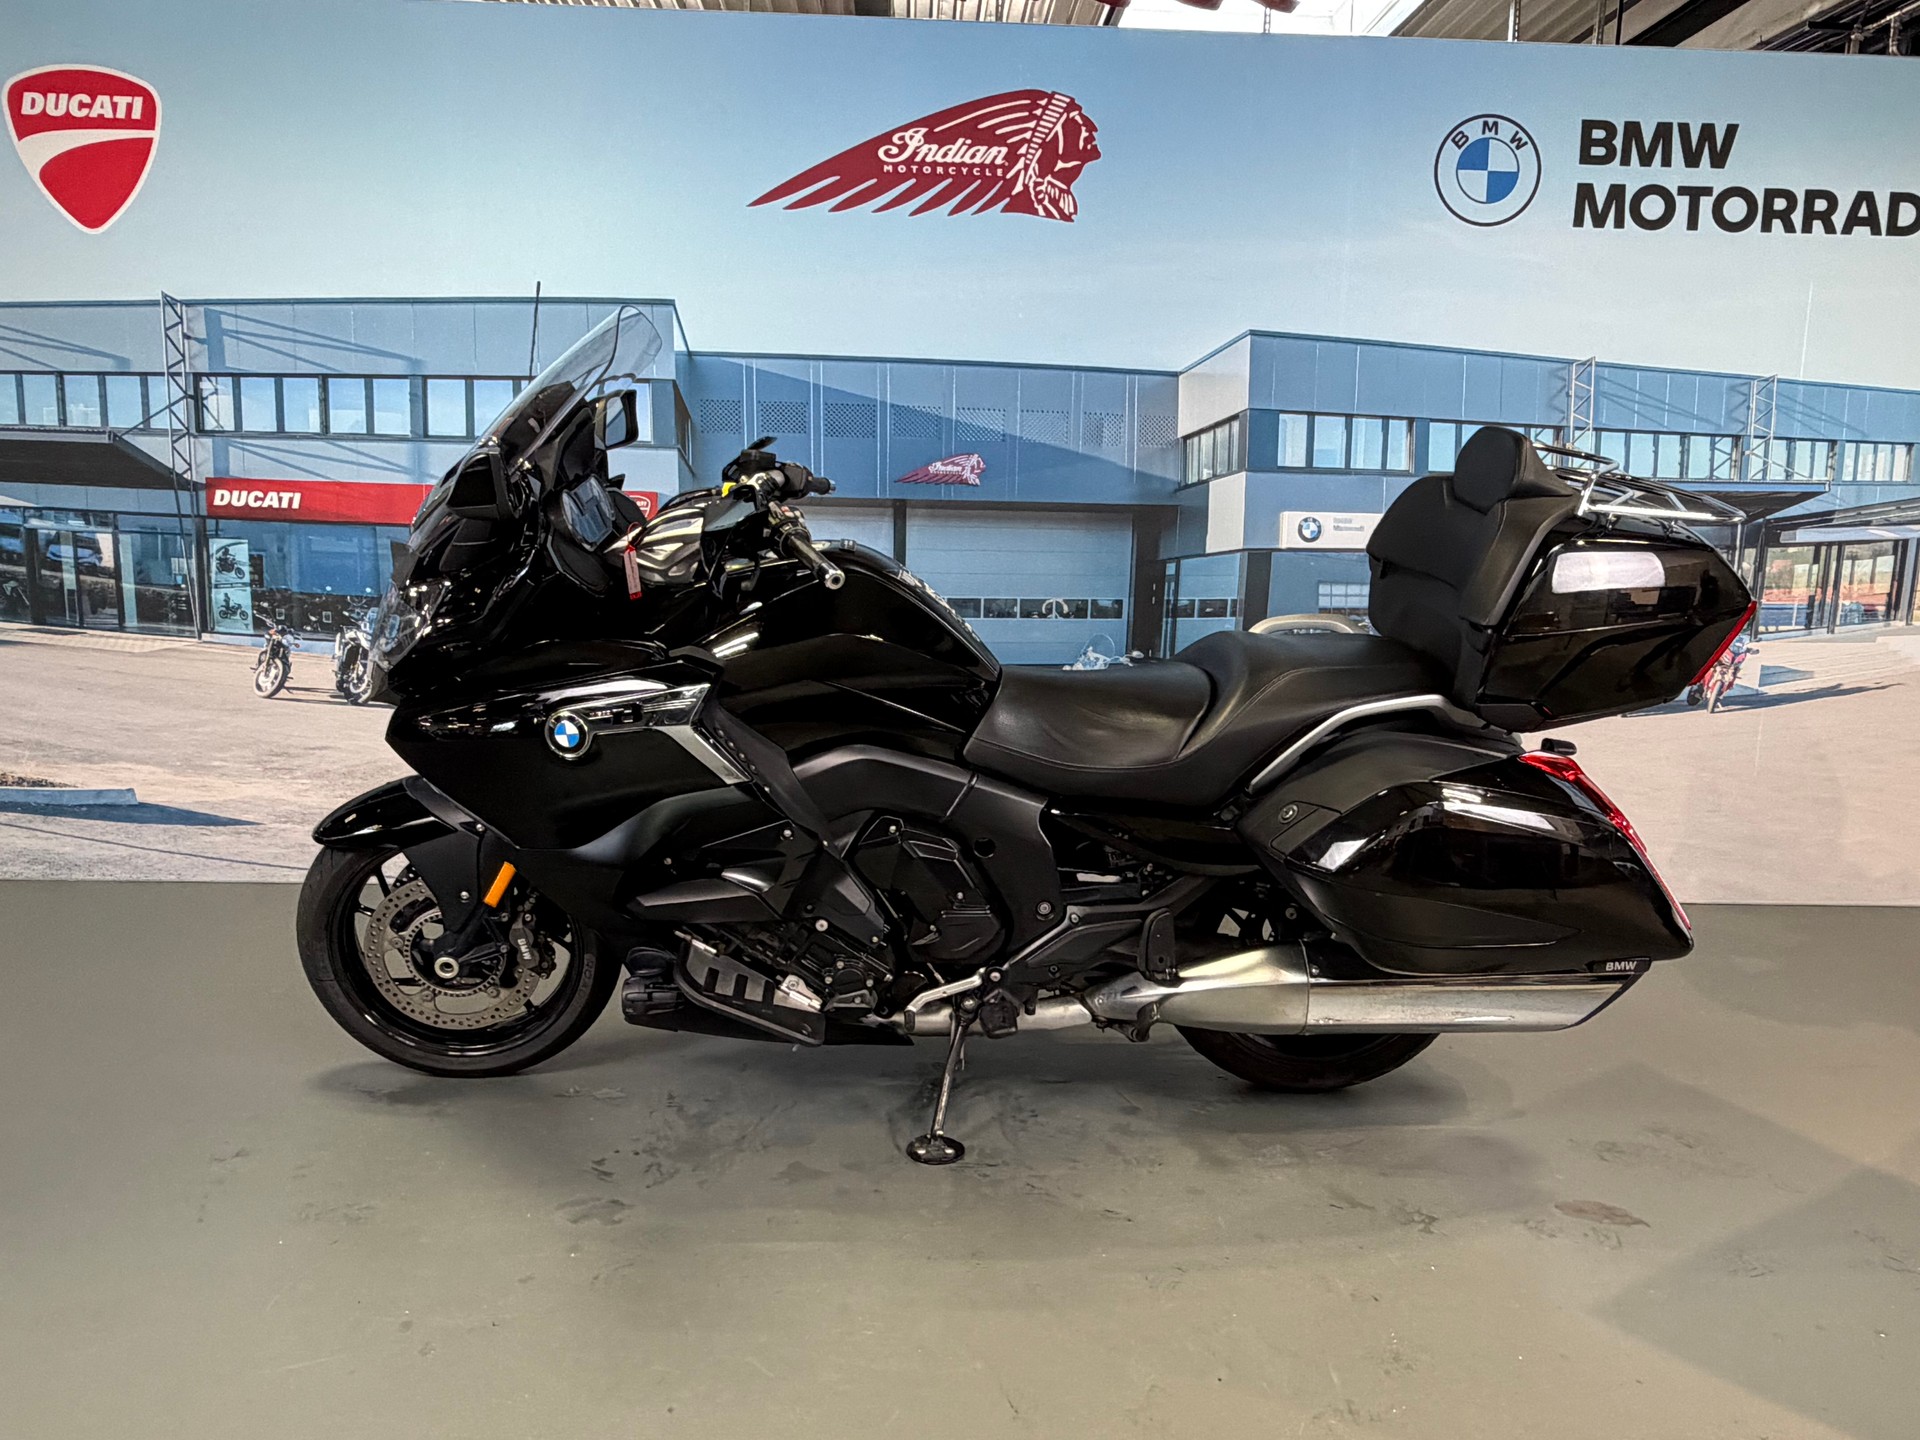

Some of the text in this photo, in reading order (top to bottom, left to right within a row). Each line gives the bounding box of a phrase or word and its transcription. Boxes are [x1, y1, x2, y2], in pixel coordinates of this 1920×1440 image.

[20, 91, 143, 120] DUCATI
[878, 127, 1008, 165] Indian
[1450, 120, 1529, 151] BMW
[1578, 119, 1740, 169] BMW
[883, 164, 1004, 176] MOTORCYCLE
[1572, 183, 1920, 236] MOTORRAD
[213, 489, 302, 509] DUCATI
[517, 938, 532, 960] BMW
[1605, 961, 1637, 971] BMW
